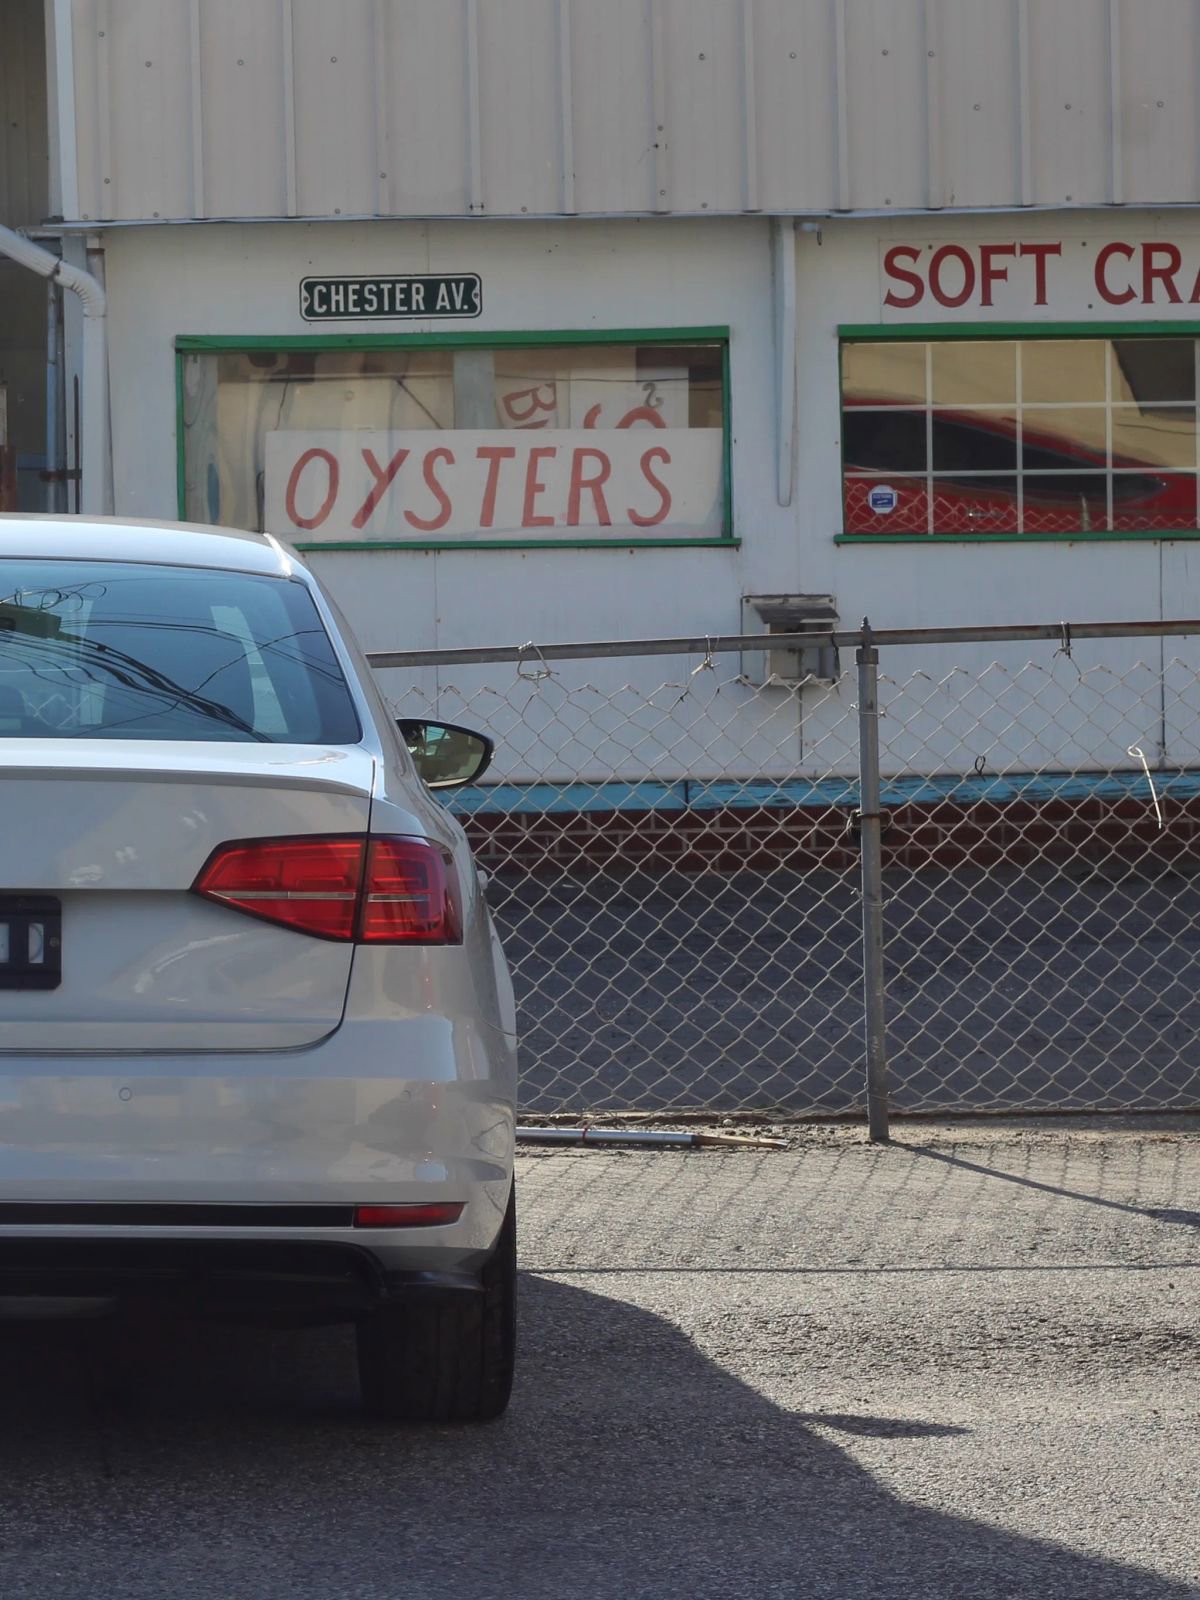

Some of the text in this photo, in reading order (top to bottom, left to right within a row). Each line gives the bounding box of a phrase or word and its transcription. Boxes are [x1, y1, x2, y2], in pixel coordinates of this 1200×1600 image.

[312, 283, 426, 313] CHESTER
[883, 241, 1200, 308] SOFT CR
[285, 446, 672, 530] OYSTERS
